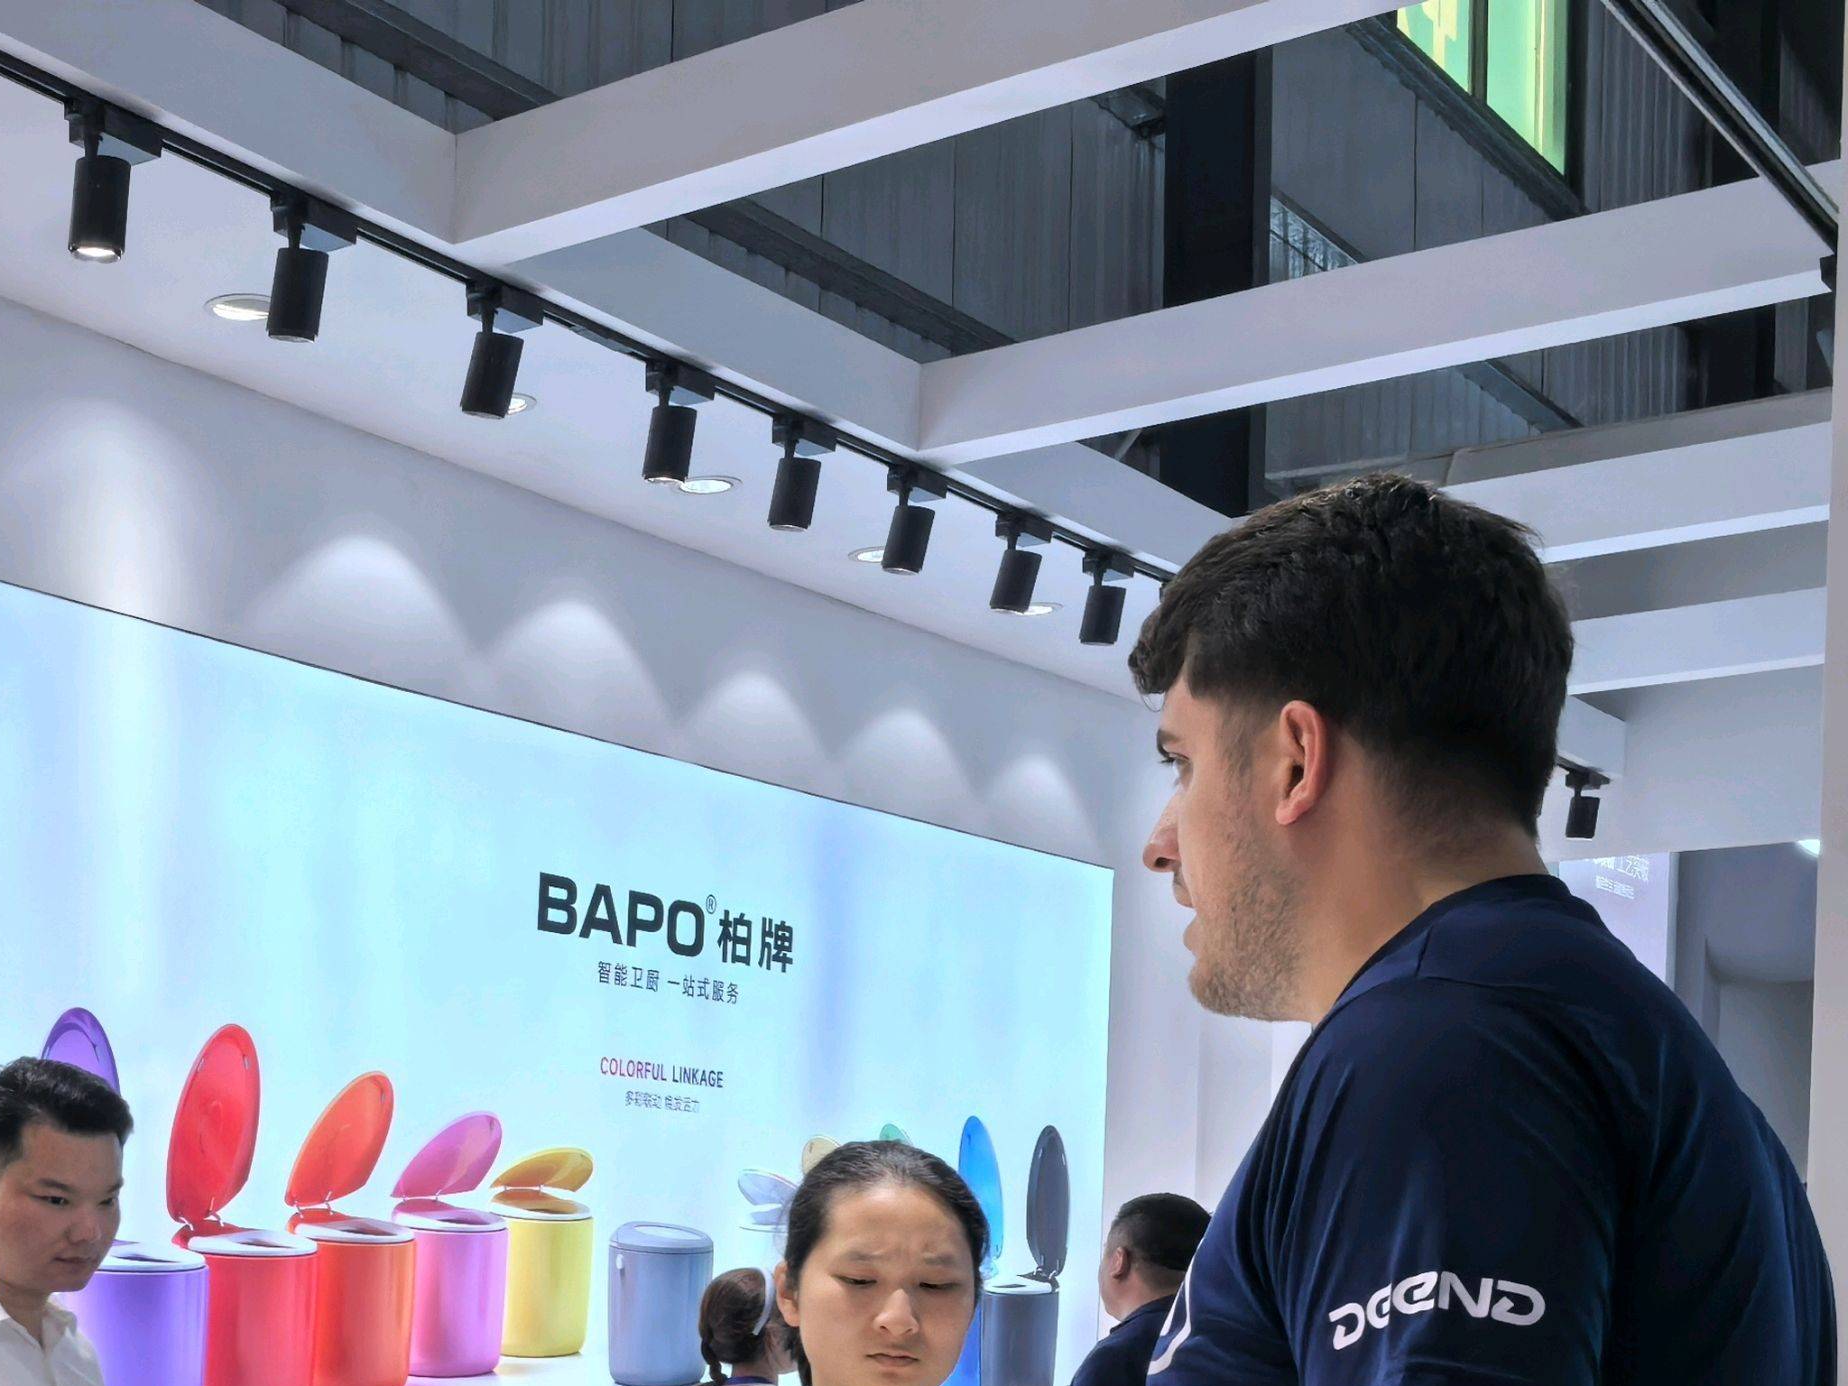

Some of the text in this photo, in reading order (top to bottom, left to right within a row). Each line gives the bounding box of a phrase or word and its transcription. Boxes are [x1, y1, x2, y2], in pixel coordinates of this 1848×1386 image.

[717, 909, 794, 973] 柏牌
[598, 960, 739, 1005] 智能卫厨 一站式服务
[600, 1056, 723, 1088] COLORFUL LINKAGE
